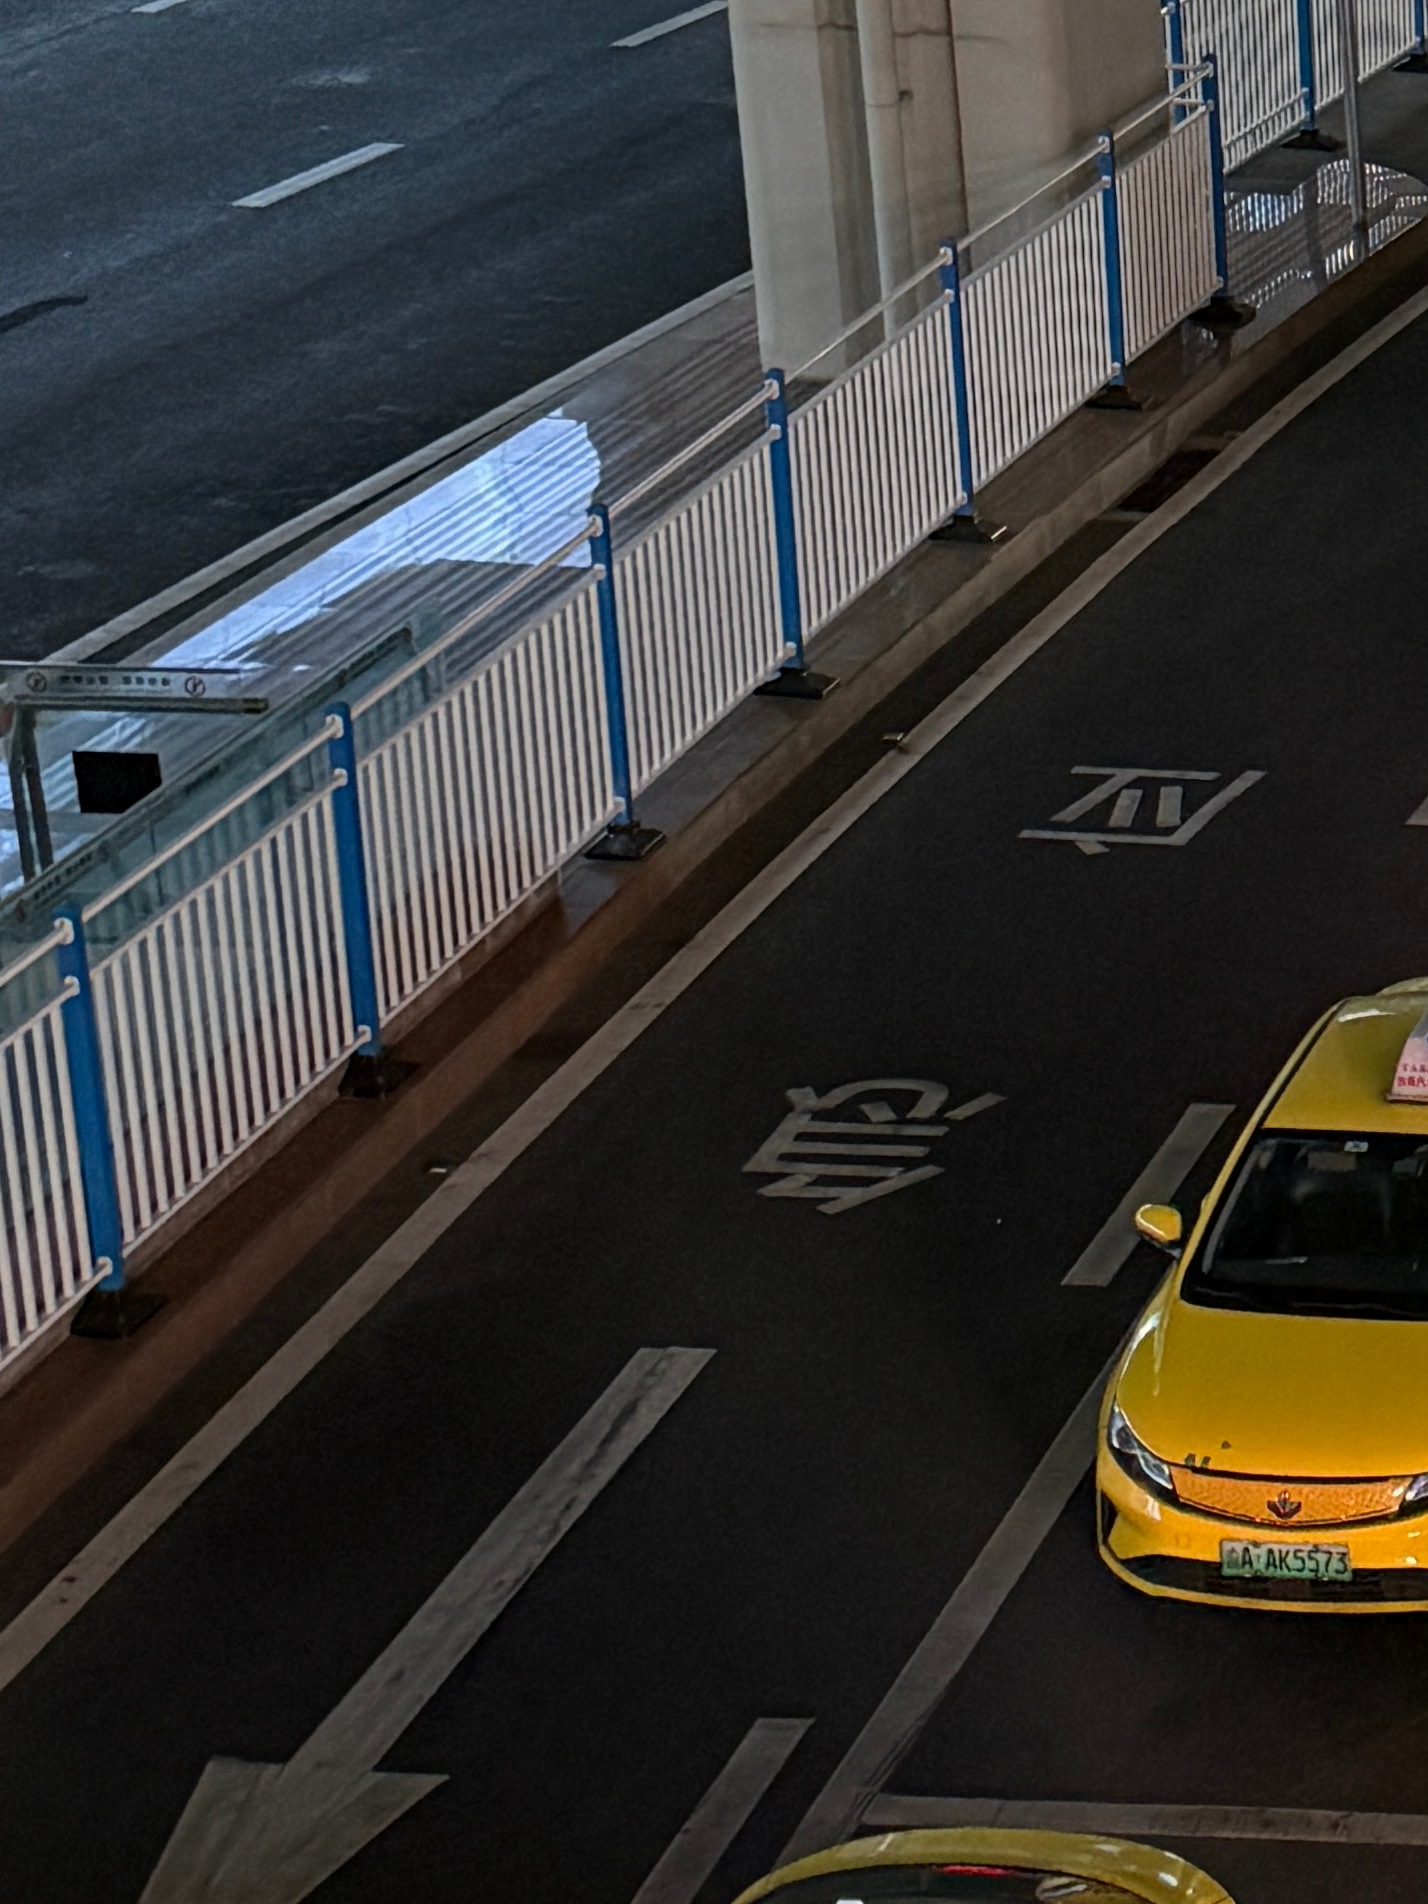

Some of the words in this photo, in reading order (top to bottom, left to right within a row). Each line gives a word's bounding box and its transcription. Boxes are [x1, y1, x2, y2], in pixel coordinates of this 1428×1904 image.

[1017, 765, 1269, 856] 应
[742, 1079, 1007, 1215] 急
[1265, 1548, 1349, 1574] AK5573
